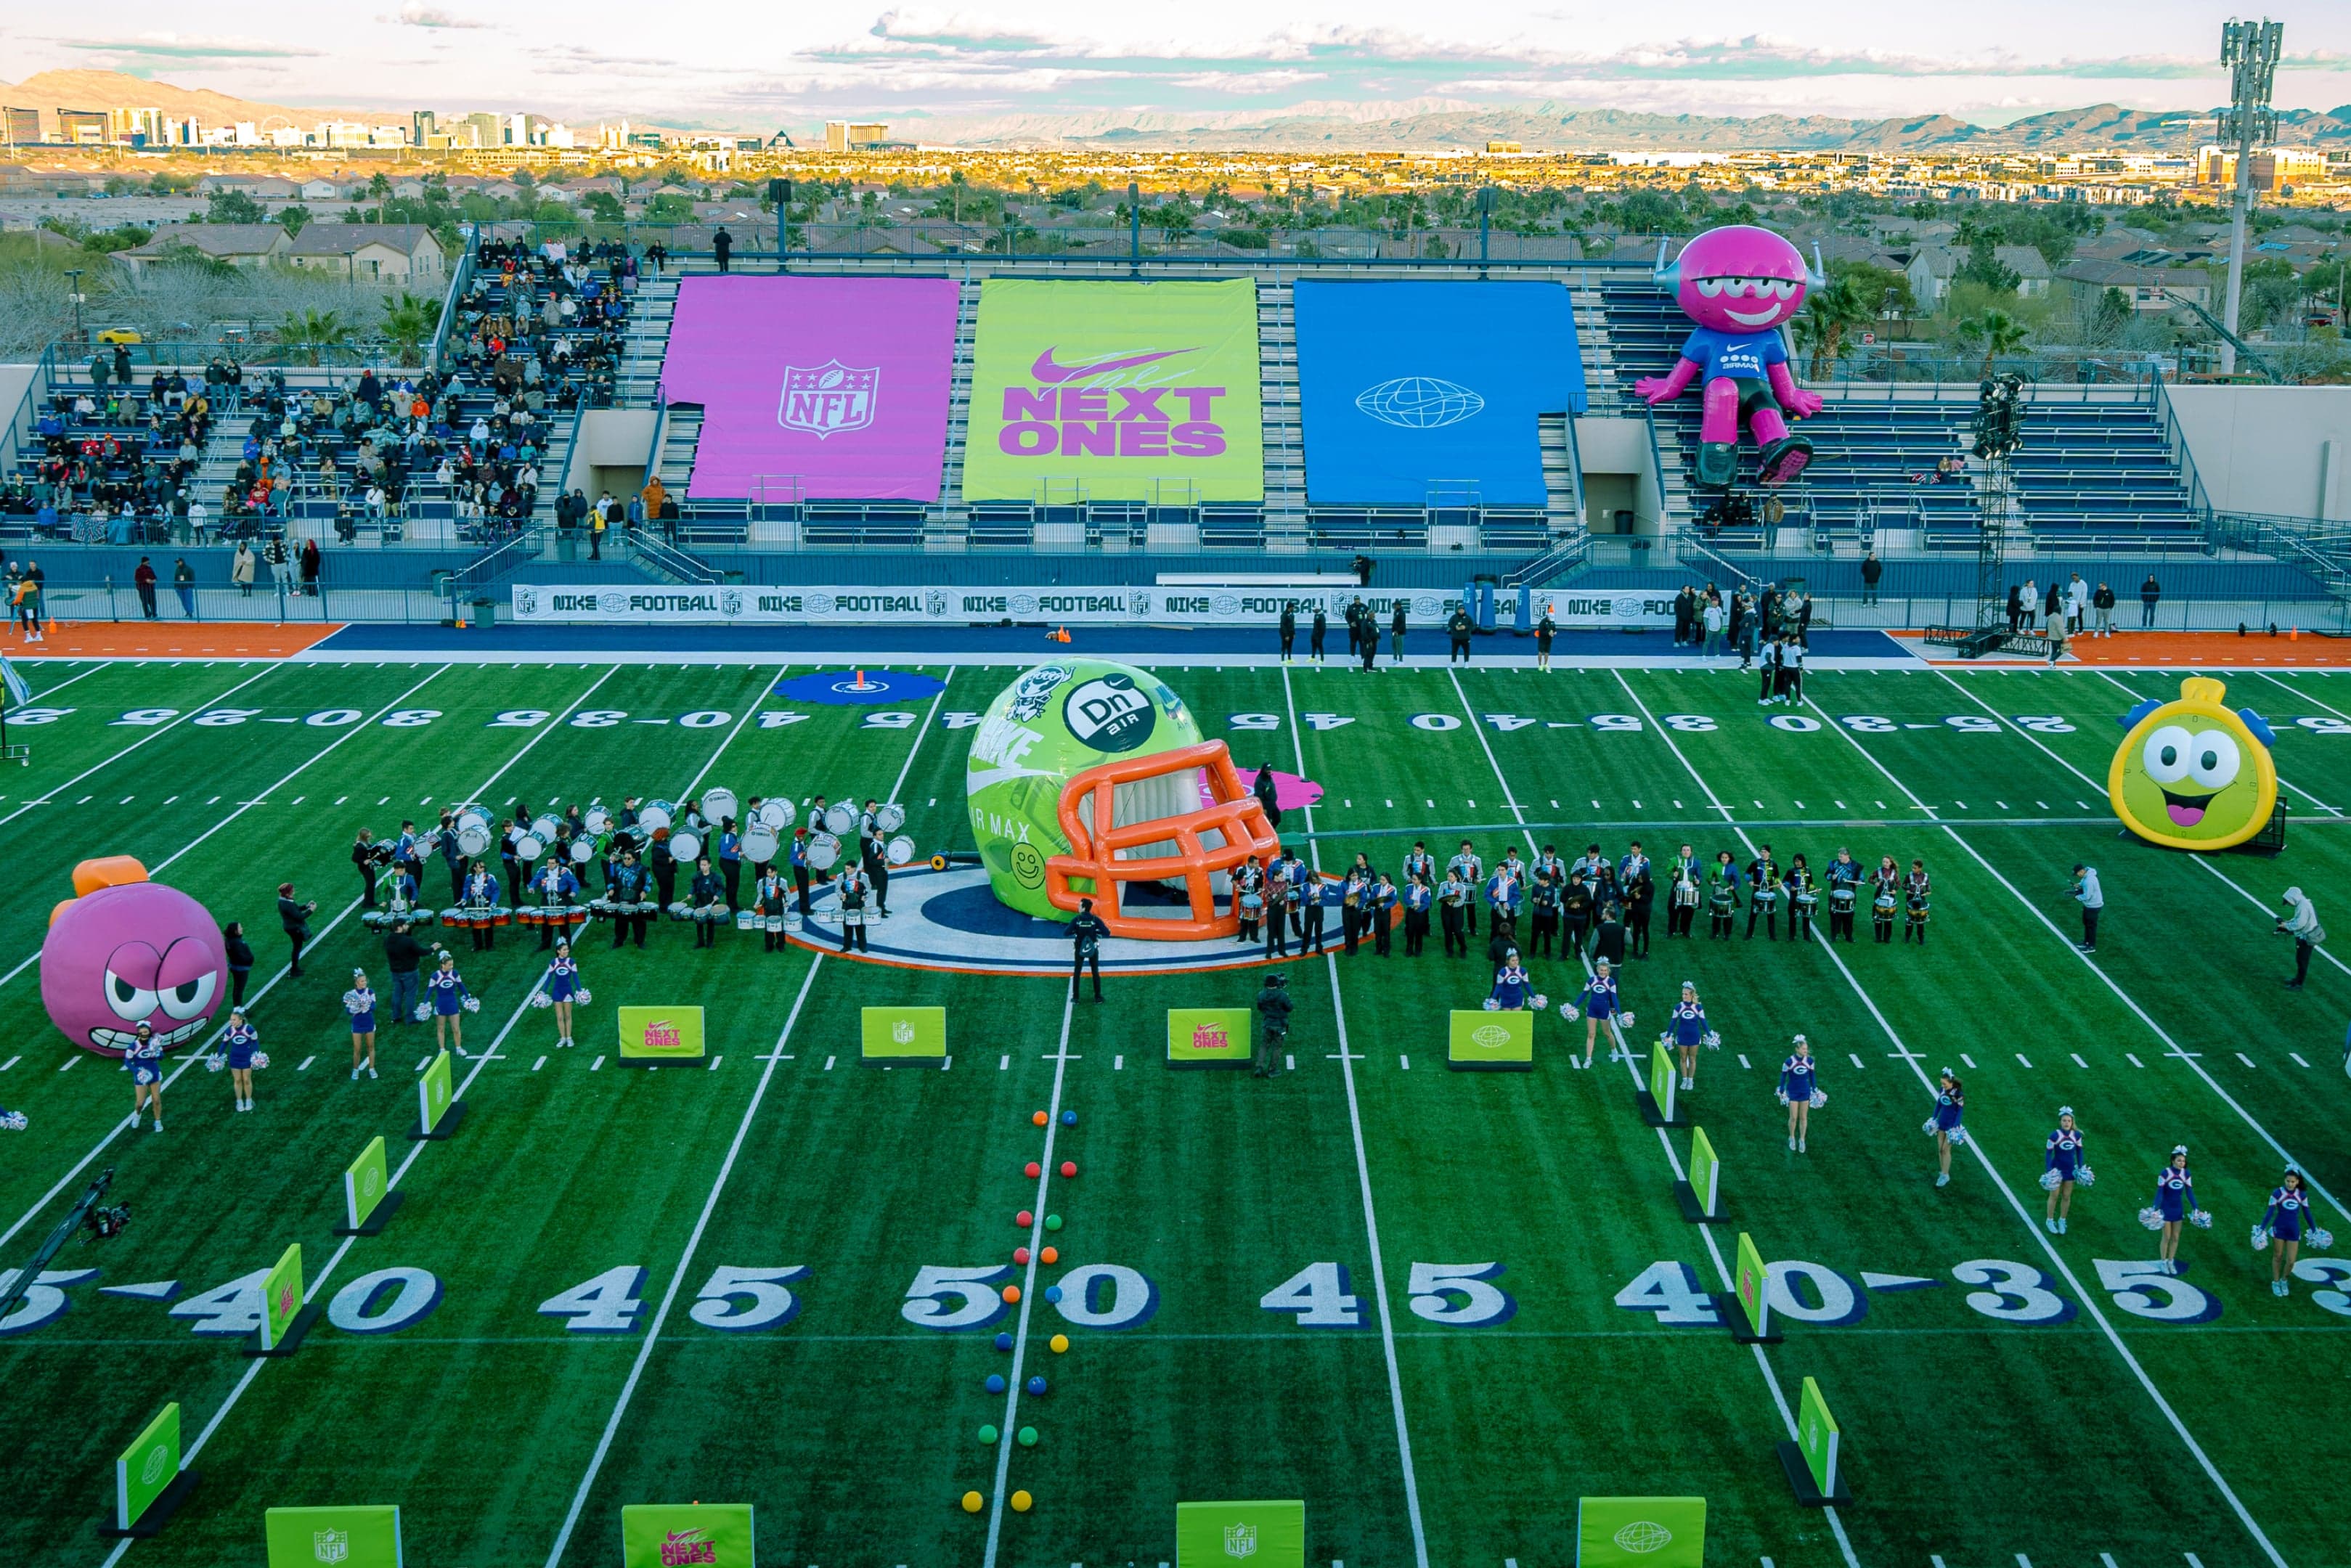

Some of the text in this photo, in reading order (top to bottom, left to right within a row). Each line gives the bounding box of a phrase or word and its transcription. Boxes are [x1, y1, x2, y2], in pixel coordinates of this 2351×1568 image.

[1040, 348, 1195, 401] The
[790, 393, 865, 428] NFL
[1003, 388, 1226, 421] NEXT
[999, 421, 1226, 457] ONES
[553, 595, 717, 611] NIKE FOOTBALL
[758, 596, 923, 612] NIKE FOOTBALL
[963, 596, 1125, 612] NIKE FOOTBALL
[1166, 597, 1210, 613] NIKE
[1568, 599, 1611, 615] NIKE
[1078, 693, 1133, 726] Dn
[990, 813, 1030, 844] MAX
[645, 1030, 680, 1039] NEXT
[2059, 1140, 2074, 1150] G
[2168, 1180, 2184, 1189] G
[2282, 1199, 2299, 1209] G
[661, 1540, 716, 1554] NEXT
[661, 1553, 717, 1567] ONES
